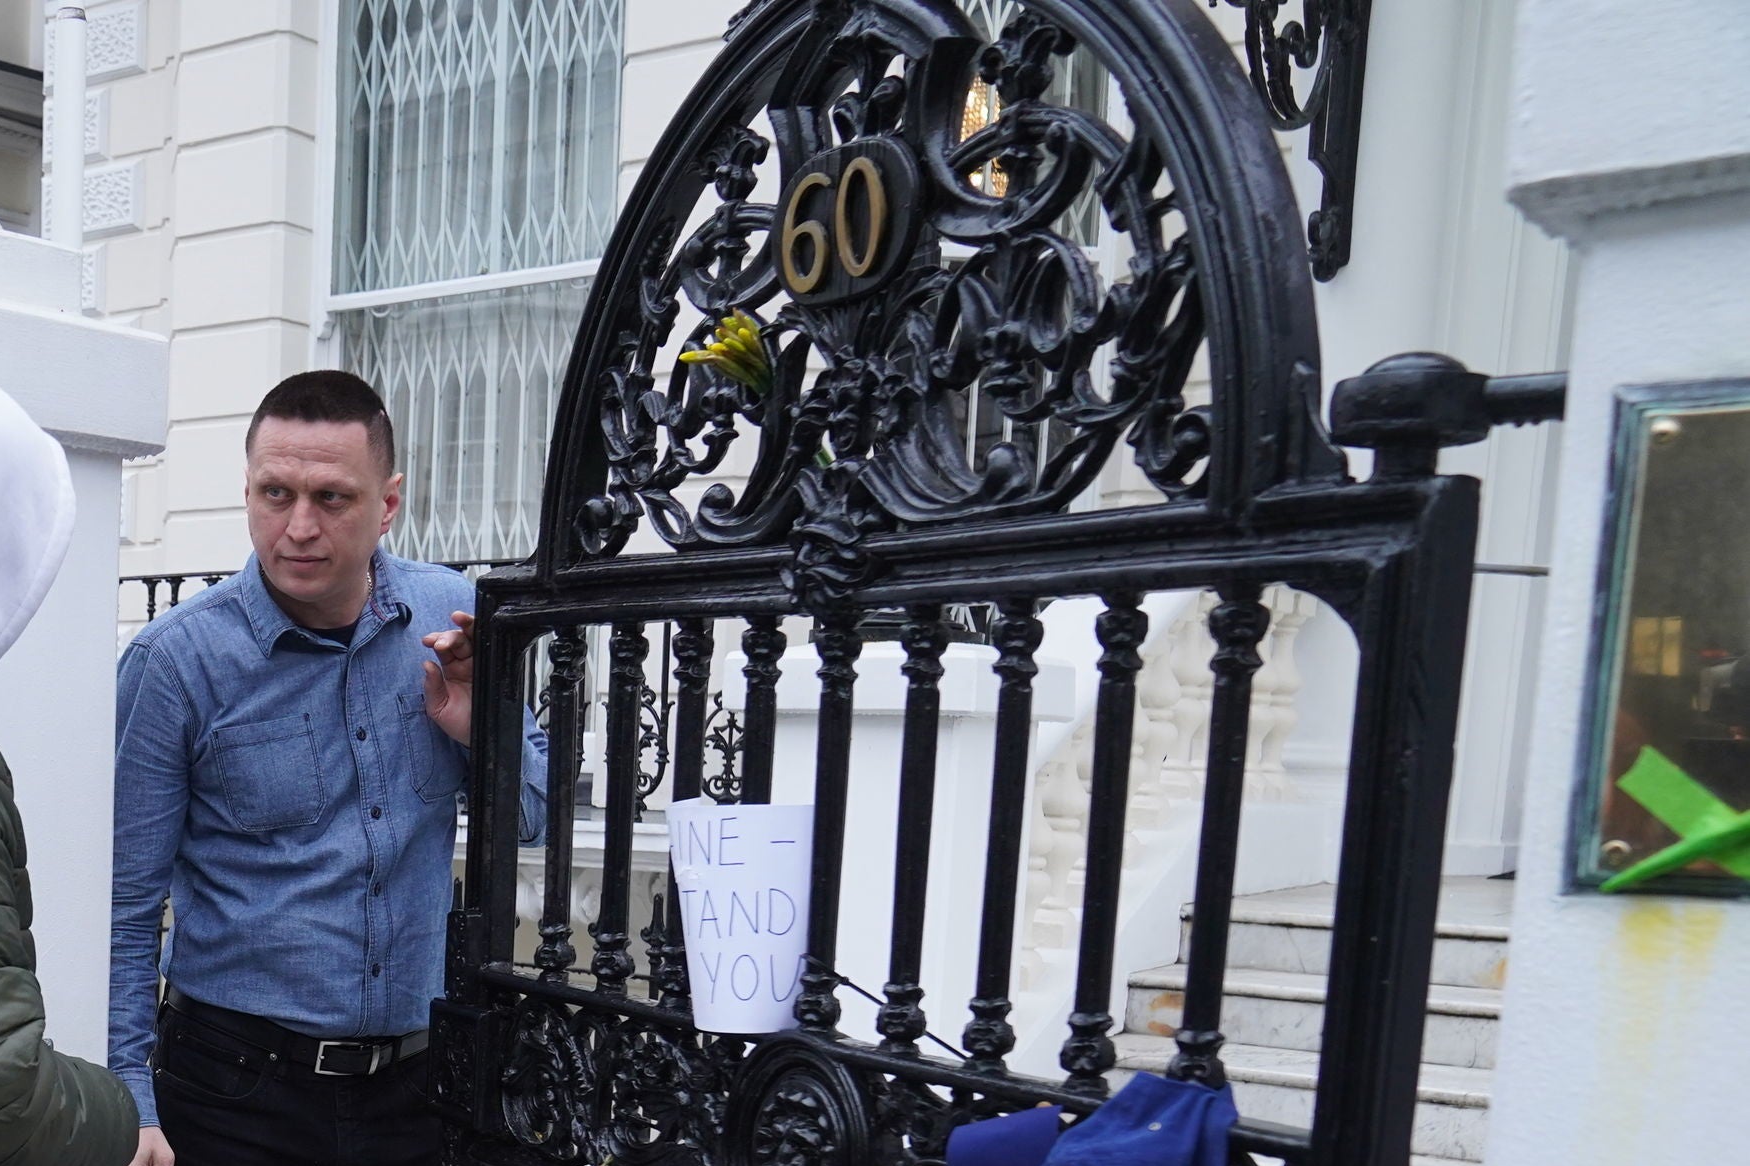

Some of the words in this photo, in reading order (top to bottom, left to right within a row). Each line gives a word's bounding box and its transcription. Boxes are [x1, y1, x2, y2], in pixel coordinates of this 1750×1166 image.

[781, 156, 888, 294] 60
[669, 816, 745, 867] INE
[681, 887, 796, 939] TAND
[700, 951, 805, 1004] YOU
